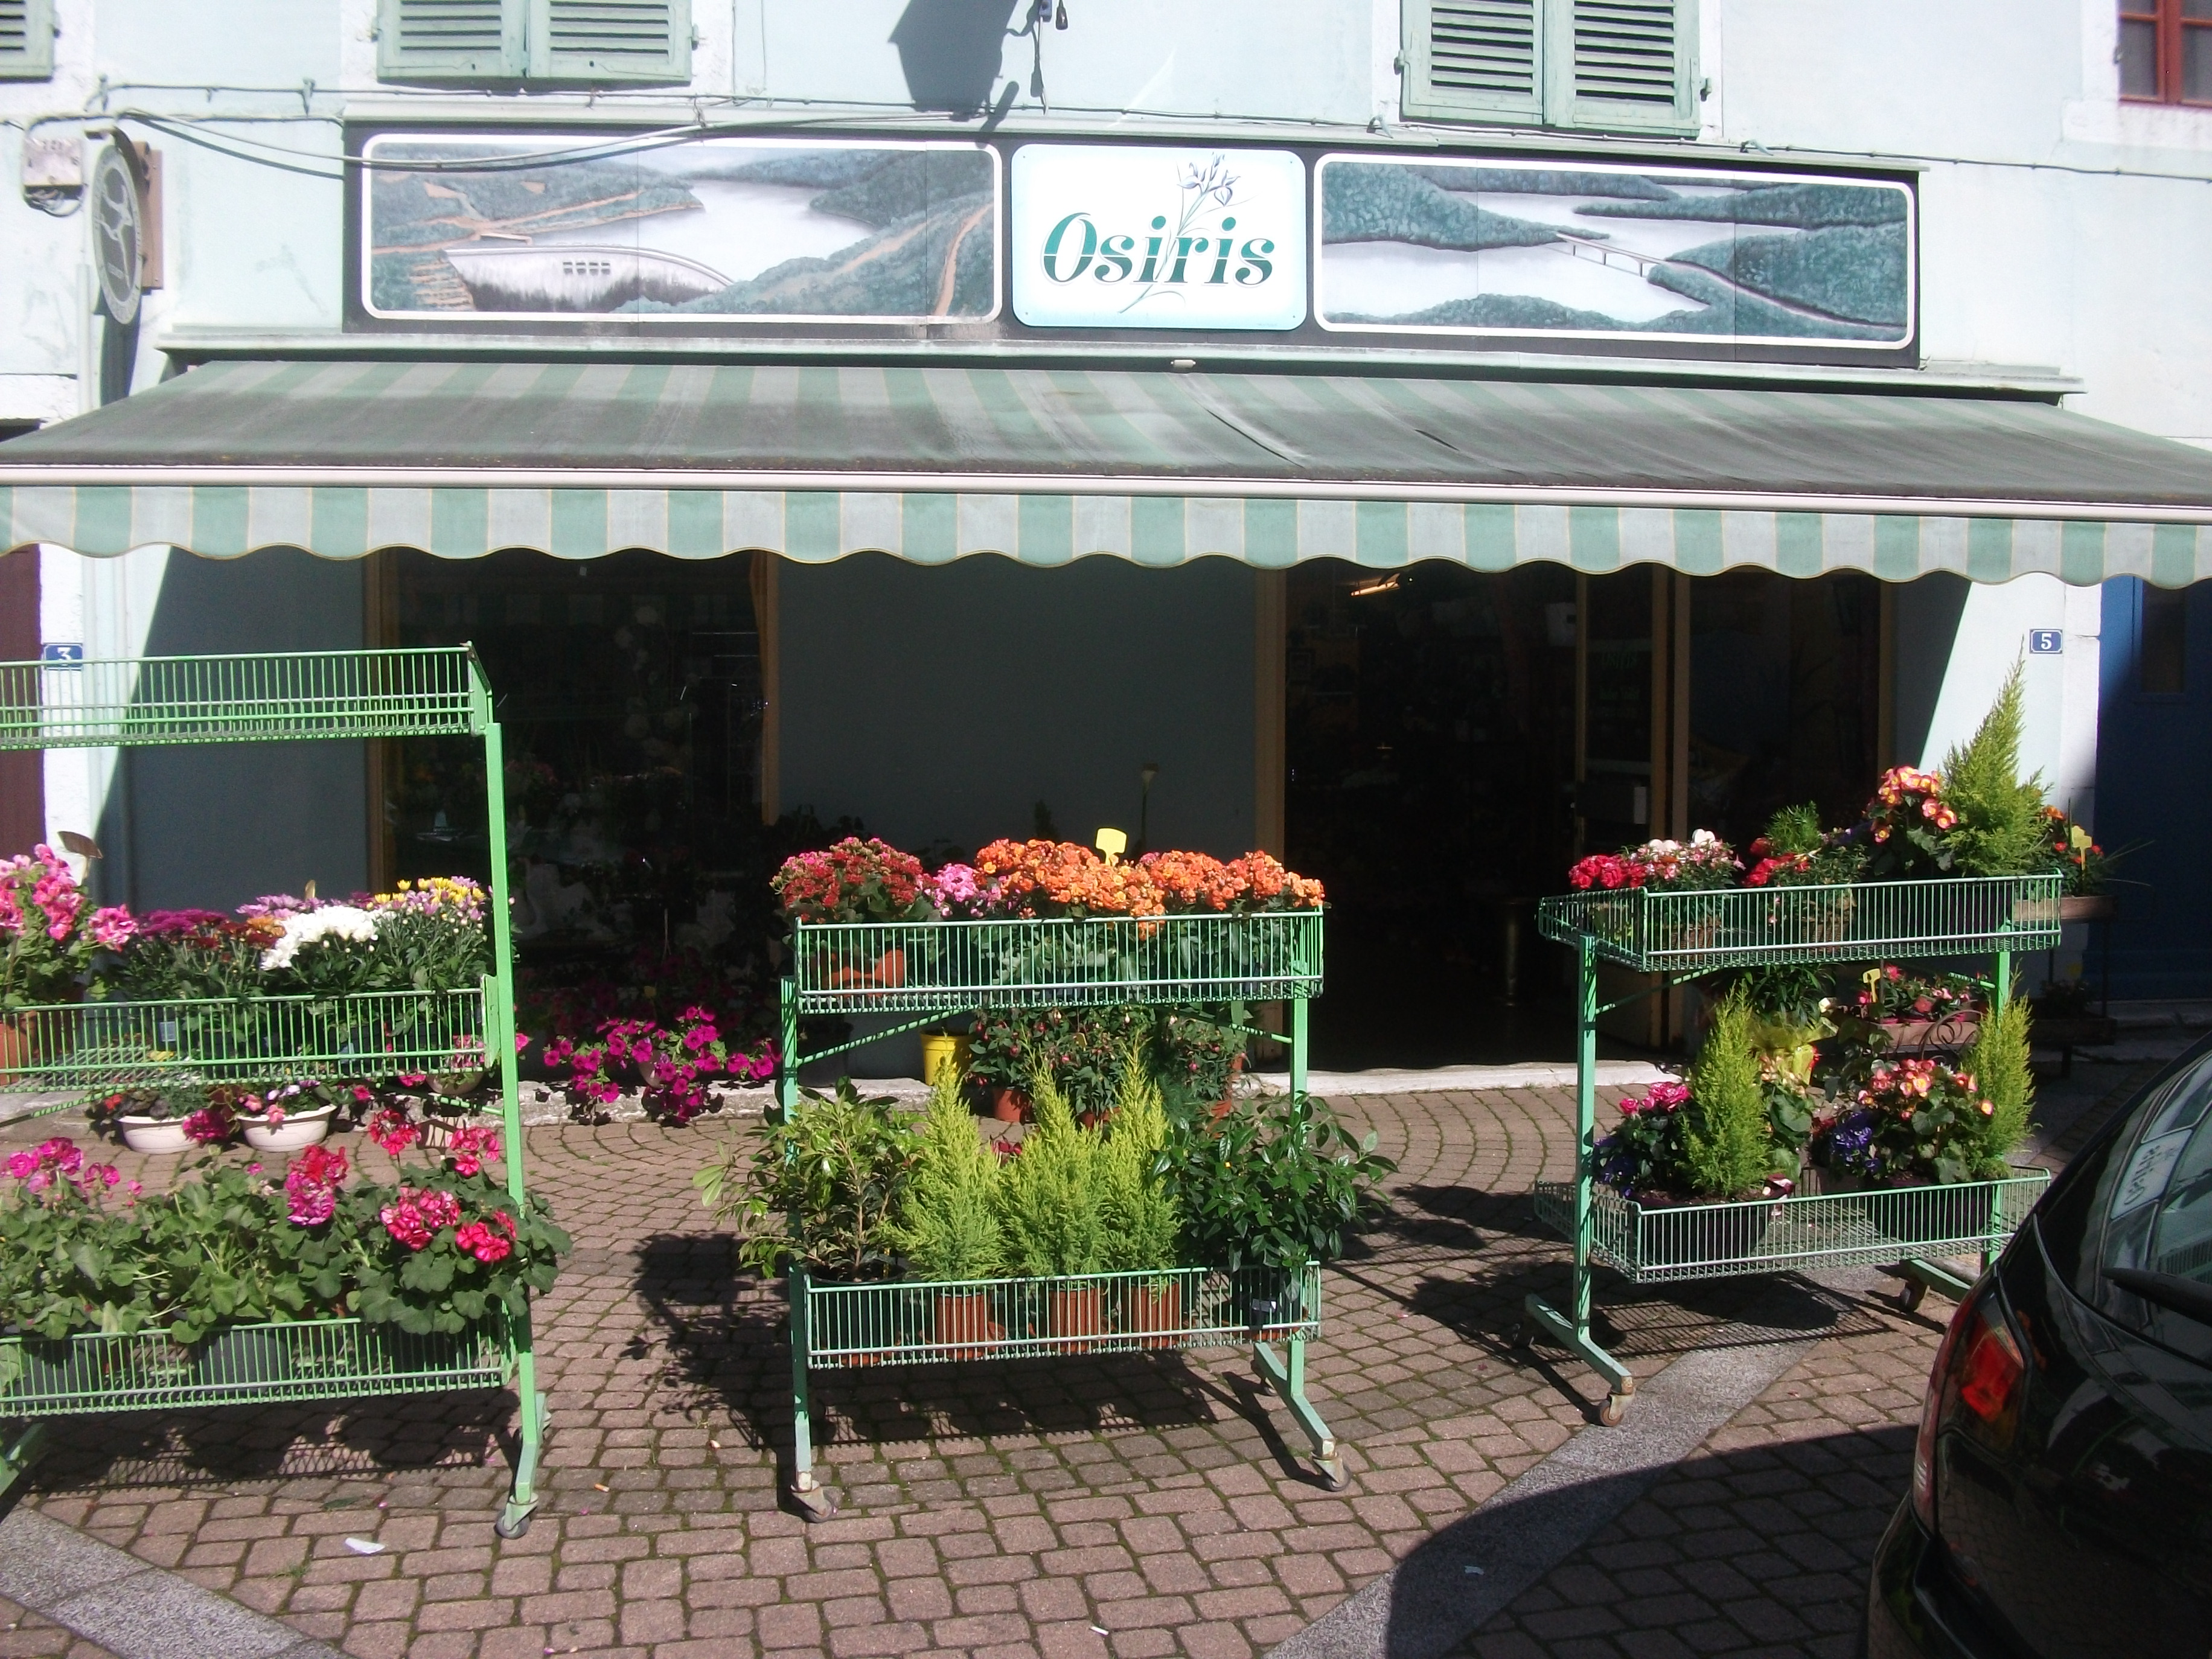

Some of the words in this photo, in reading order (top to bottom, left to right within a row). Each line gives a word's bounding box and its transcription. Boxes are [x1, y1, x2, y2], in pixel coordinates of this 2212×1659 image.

[1043, 212, 1275, 286] Osiris
[2041, 633, 2052, 650] 5
[57, 647, 72, 666] 3
